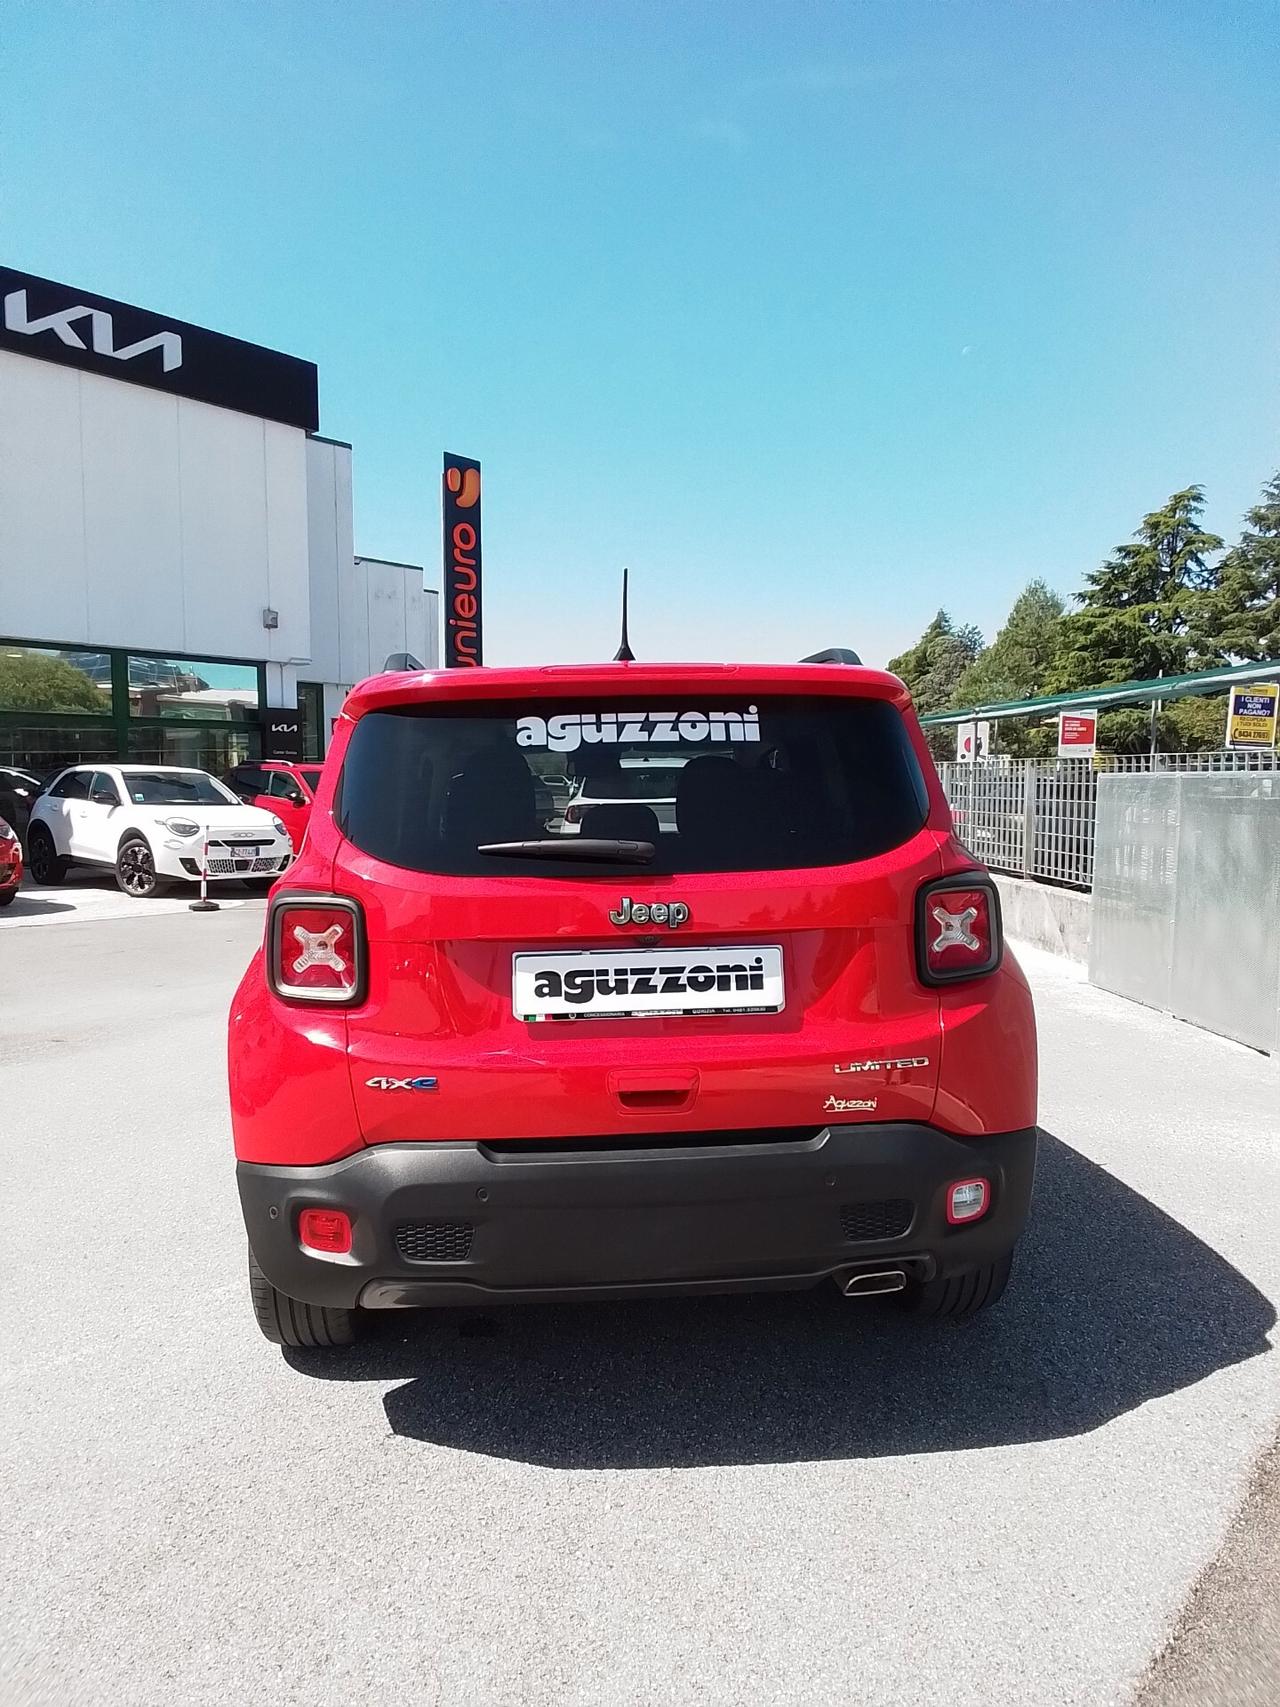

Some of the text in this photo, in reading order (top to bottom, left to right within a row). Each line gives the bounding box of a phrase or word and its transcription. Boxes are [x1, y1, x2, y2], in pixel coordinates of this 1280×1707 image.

[4, 288, 183, 373] KIA
[271, 723, 298, 732] KIA
[516, 704, 761, 752] aguzzoni
[608, 897, 689, 928] Jeep
[534, 956, 764, 1004] aguzzoni
[834, 1056, 929, 1073] LIMITED
